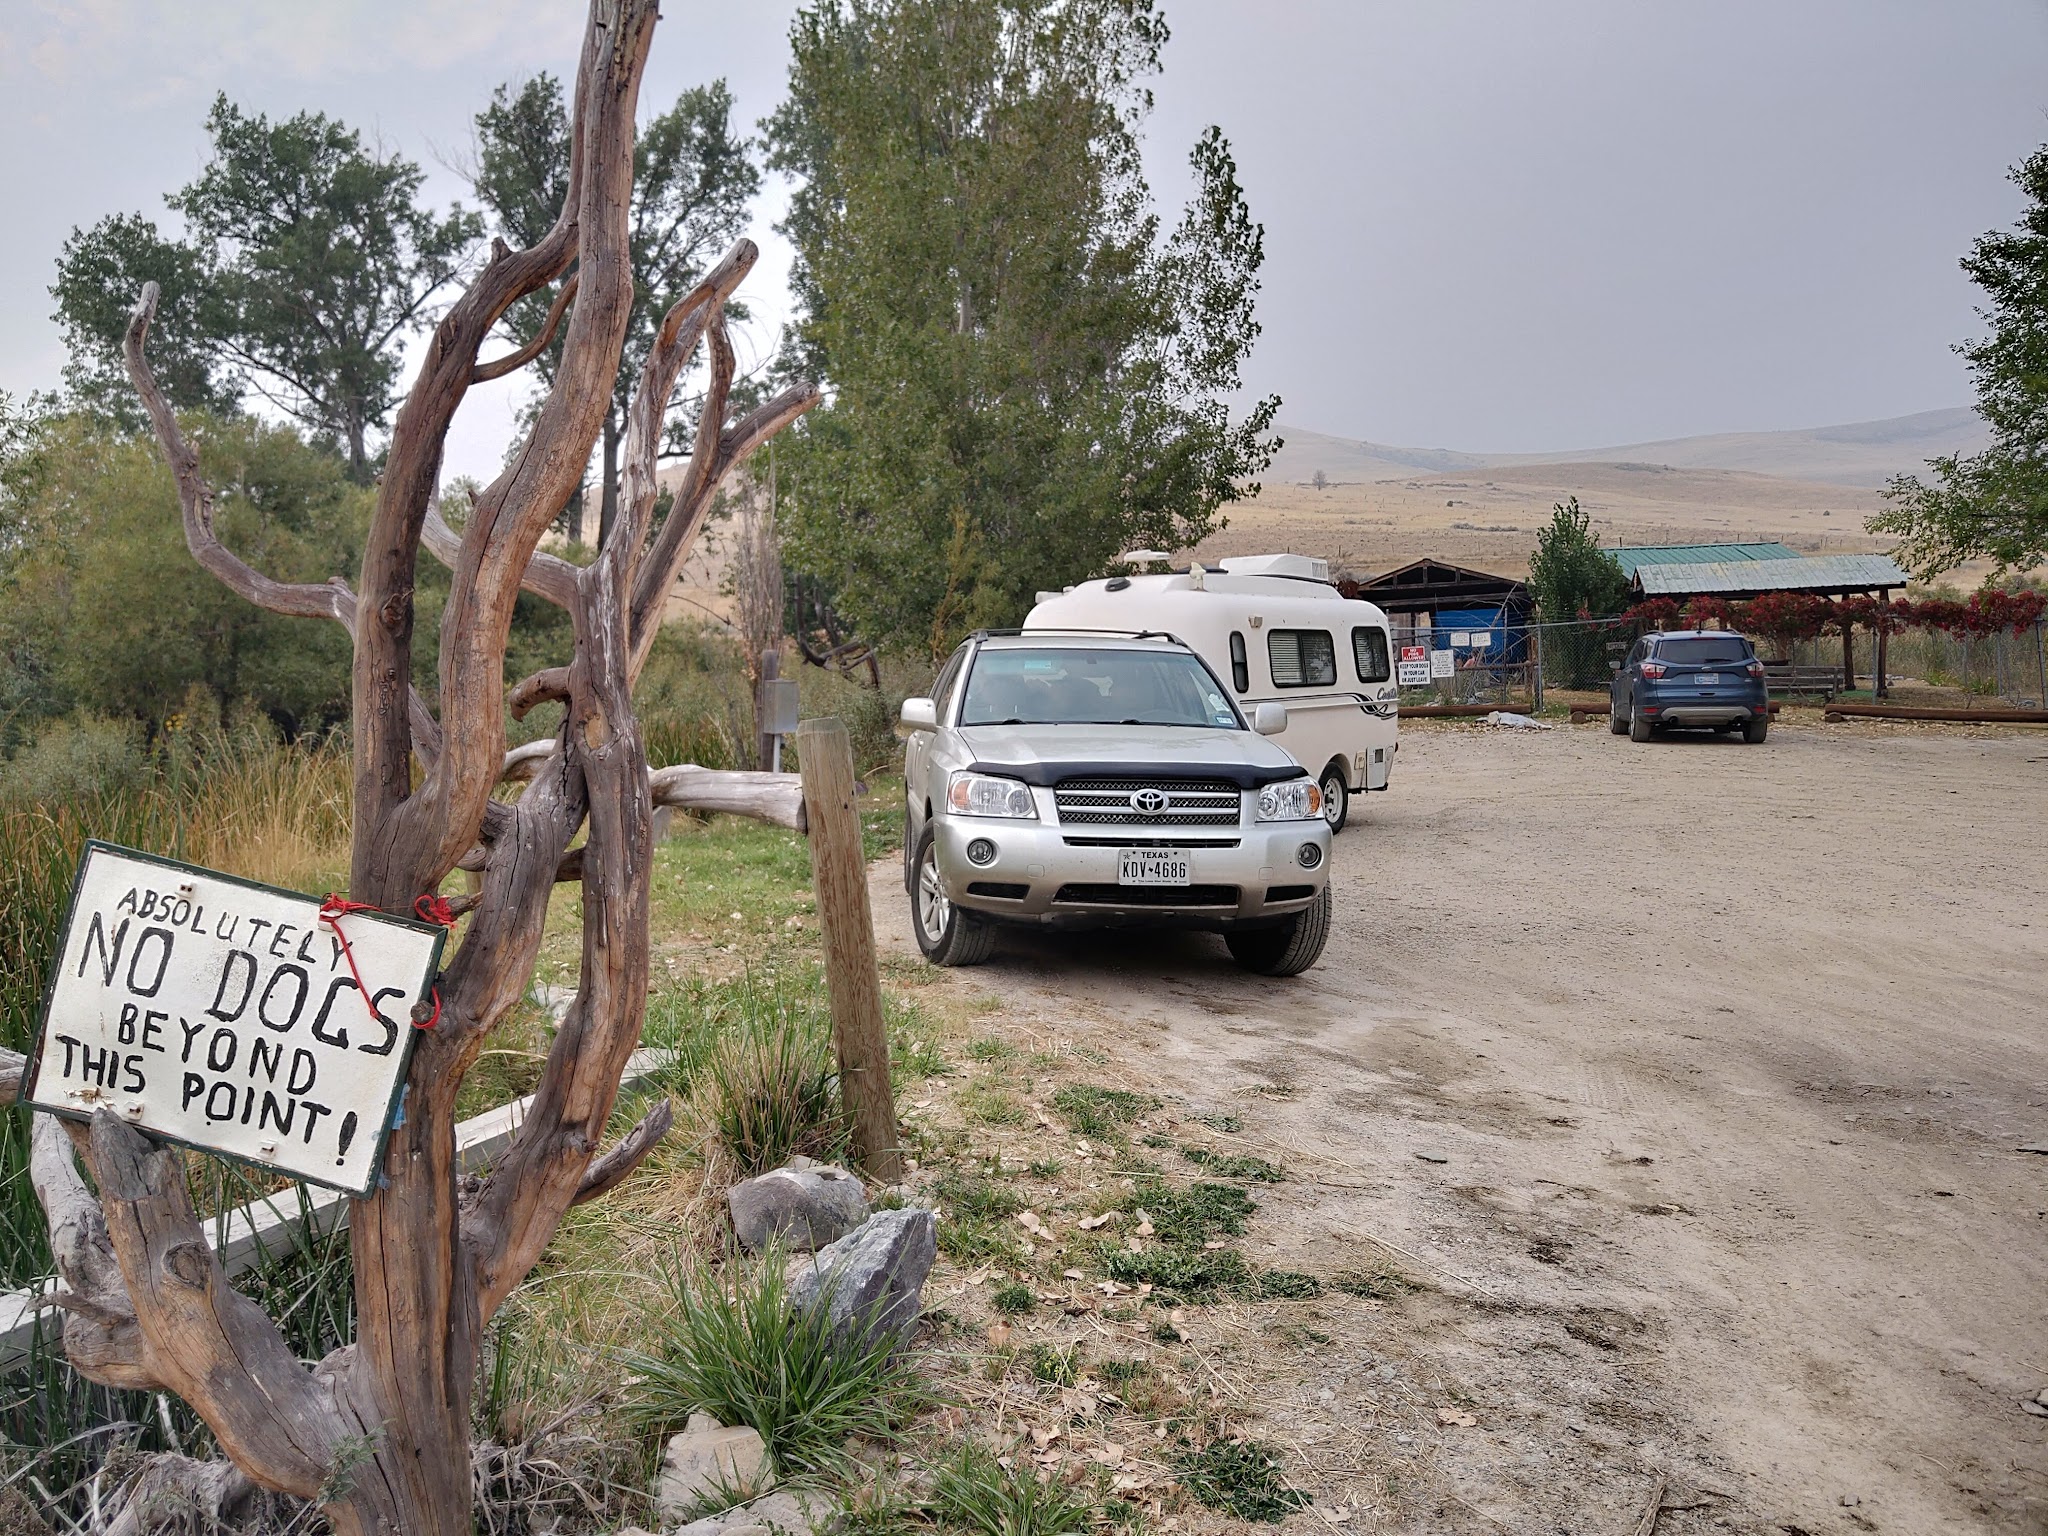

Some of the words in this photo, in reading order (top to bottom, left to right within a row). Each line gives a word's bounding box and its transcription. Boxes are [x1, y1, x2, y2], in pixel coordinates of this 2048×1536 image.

[1141, 851, 1169, 859] TEXAS
[118, 887, 353, 971] ABSOLUTELY
[78, 911, 175, 998] NO
[205, 949, 405, 1056] DOGS
[55, 1032, 146, 1093] THIS
[118, 1003, 317, 1096] BEYOND
